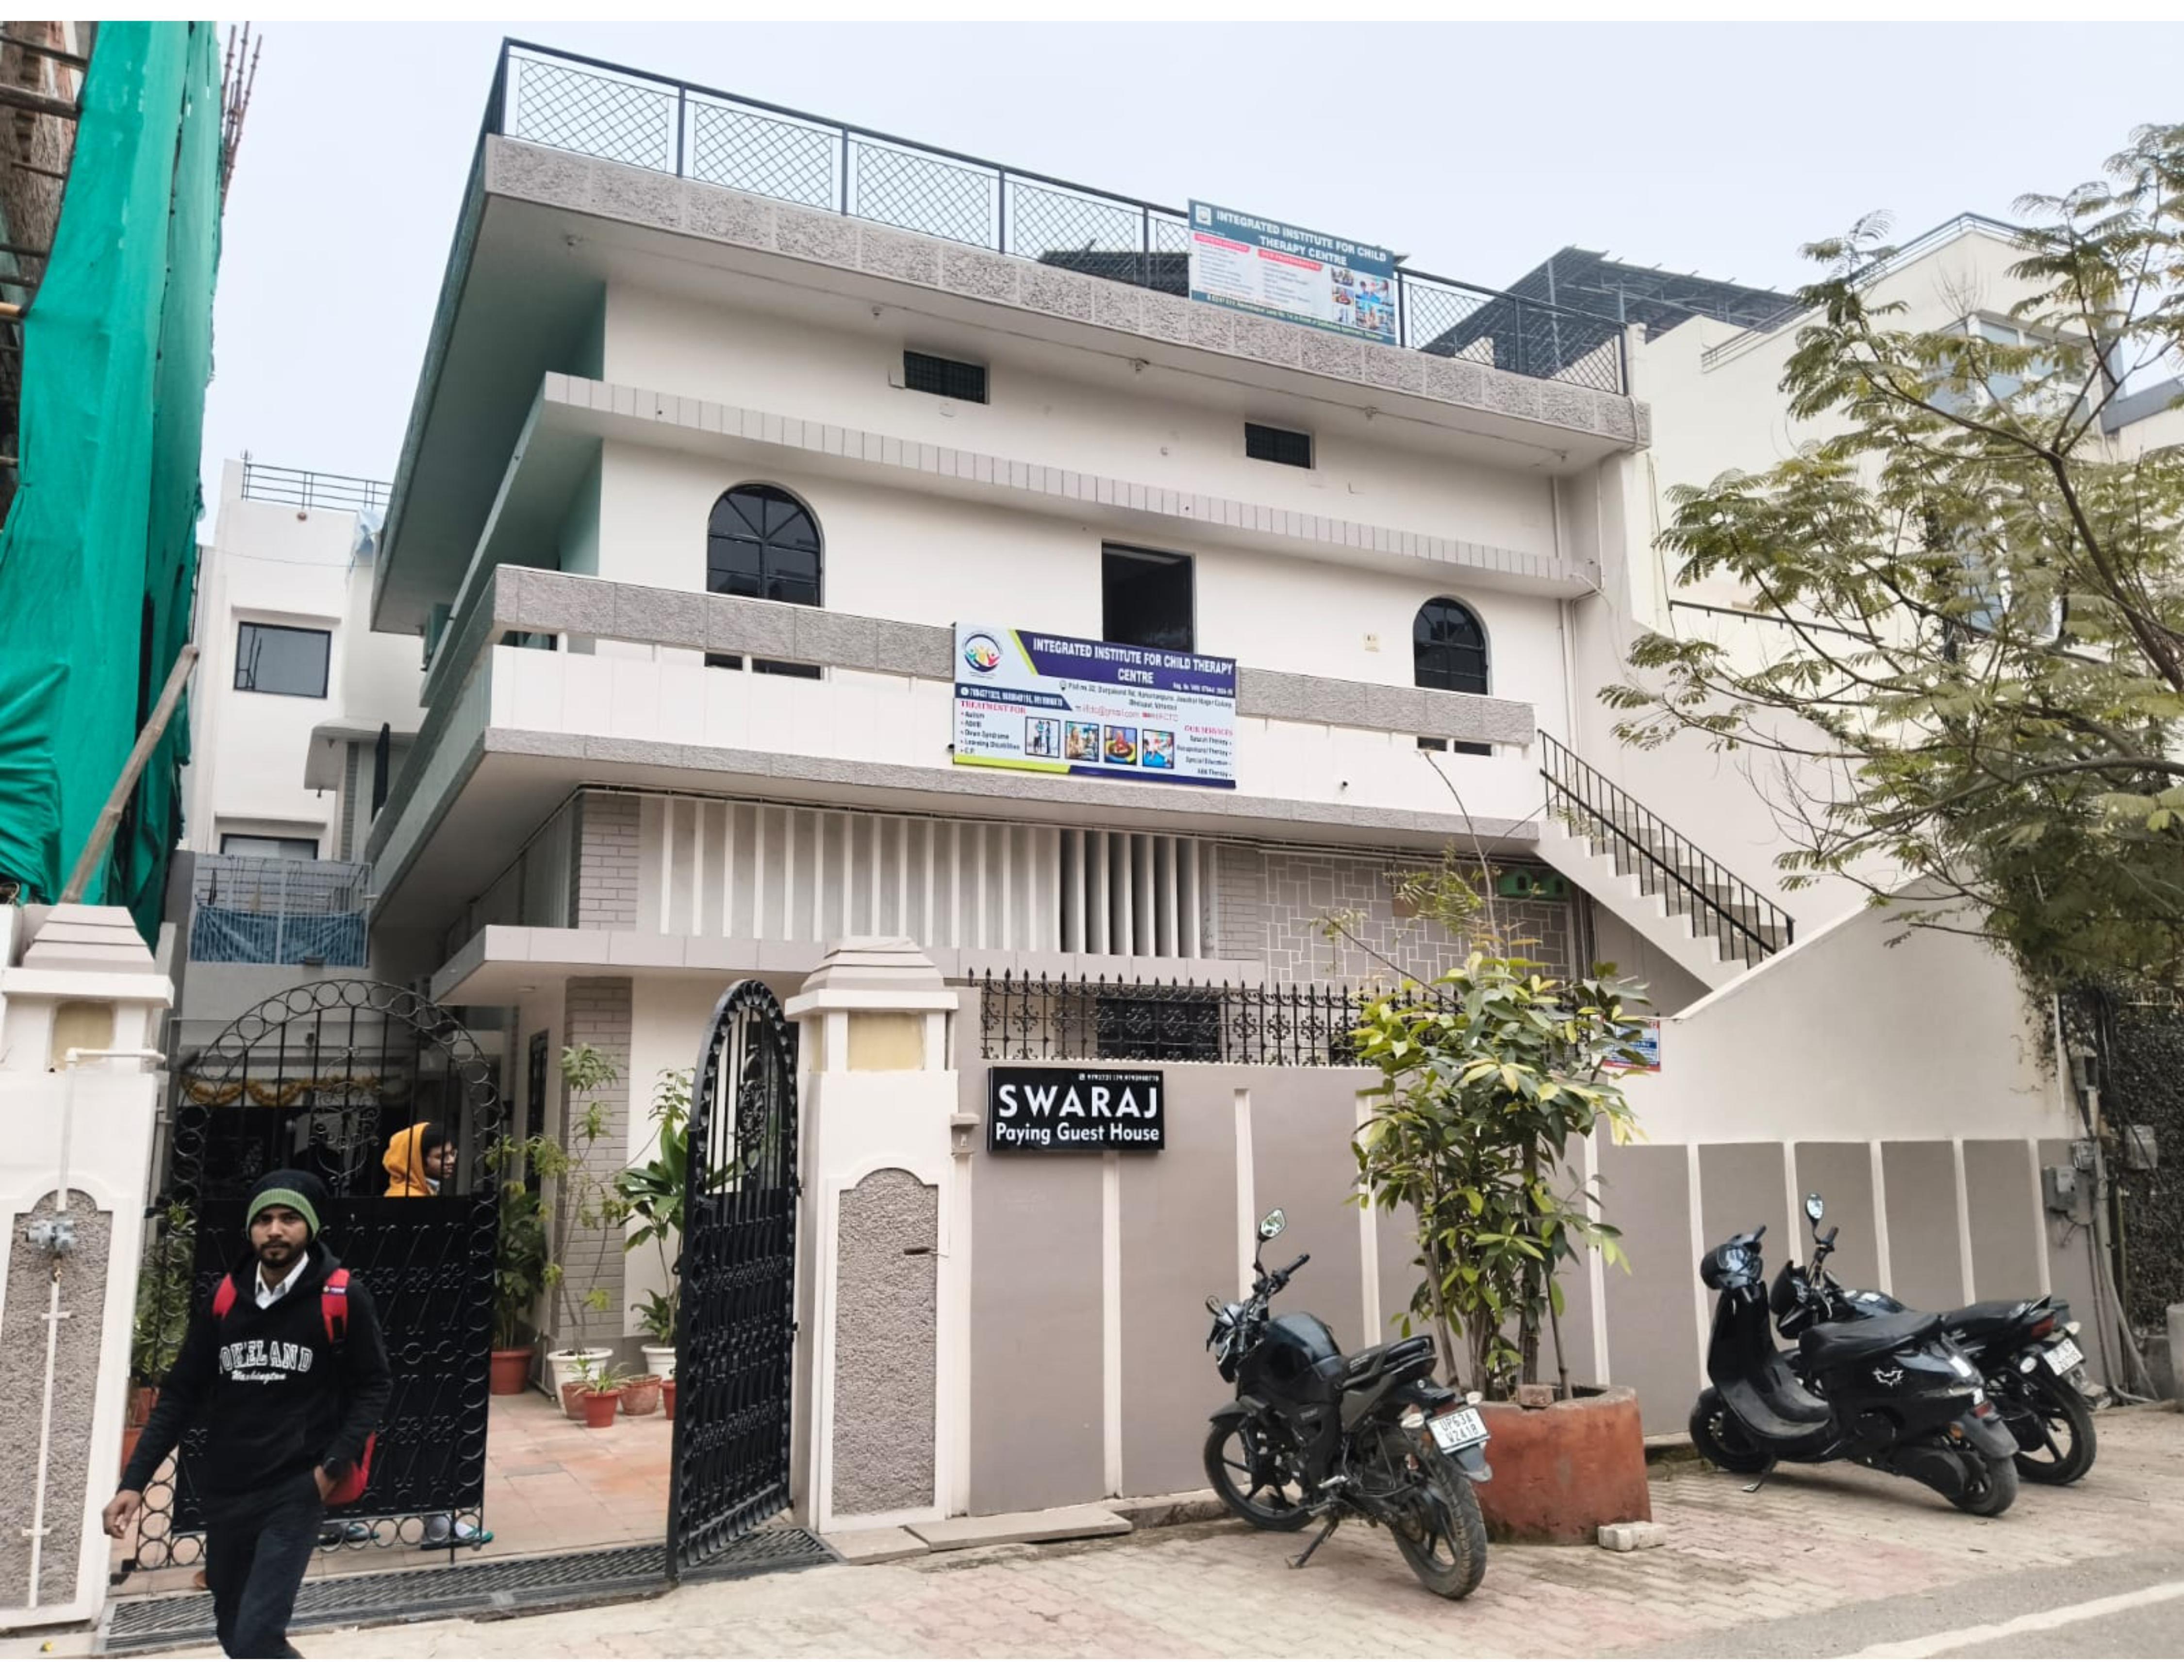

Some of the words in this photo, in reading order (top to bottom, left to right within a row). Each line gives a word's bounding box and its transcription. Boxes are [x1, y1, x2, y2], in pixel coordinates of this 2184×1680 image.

[1217, 210, 1279, 235] INTEGRATED
[1283, 227, 1333, 249] INSTITUTE
[1336, 241, 1355, 254] FOR
[1357, 246, 1386, 262] CHILD
[1259, 235, 1306, 256] THERAPY
[1308, 248, 1347, 265] CENTRE
[1033, 637, 1092, 657] INTEGRATED
[1094, 646, 1141, 664] INSTITUTE
[1144, 652, 1161, 666] FOR
[1164, 655, 1191, 669] CHILD
[1193, 659, 1233, 675] THERAPY
[1118, 668, 1154, 683] CENTRE
[961, 700, 1008, 711] TREATMENT
[1010, 706, 1026, 715] FOR
[998, 1083, 1158, 1119] SWARAJ
[995, 1122, 1051, 1146] Paying
[1057, 1122, 1105, 1141] Guest
[1110, 1123, 1159, 1141] House
